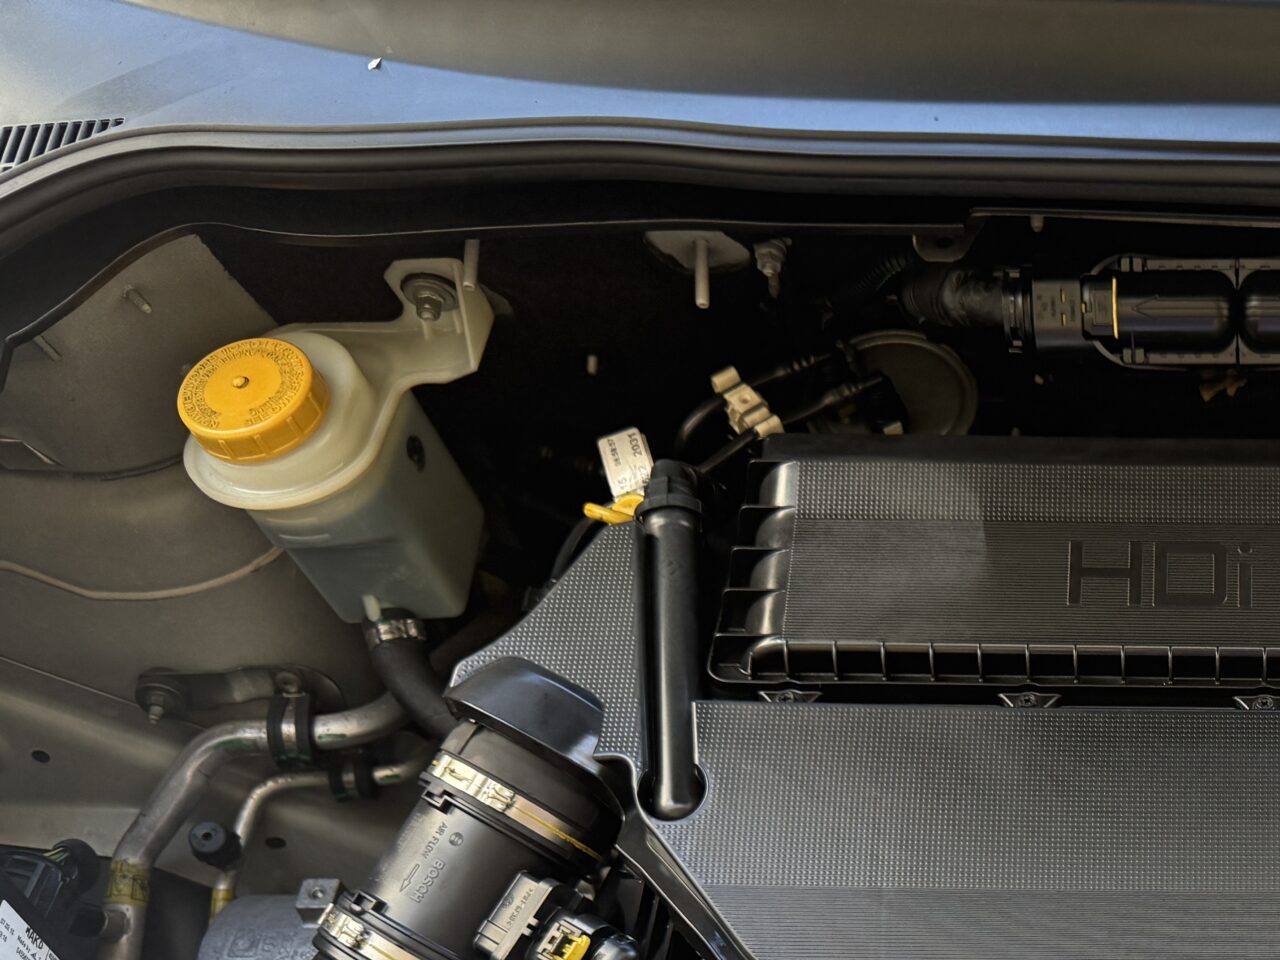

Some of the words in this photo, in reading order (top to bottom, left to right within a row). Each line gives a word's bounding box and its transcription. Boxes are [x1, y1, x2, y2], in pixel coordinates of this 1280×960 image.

[627, 433, 642, 457] 2031
[1067, 540, 1253, 608] HDi
[434, 821, 448, 836] AIR
[419, 835, 439, 860] FLOW
[408, 856, 447, 904] BOSCH
[25, 926, 44, 950] MAKO
